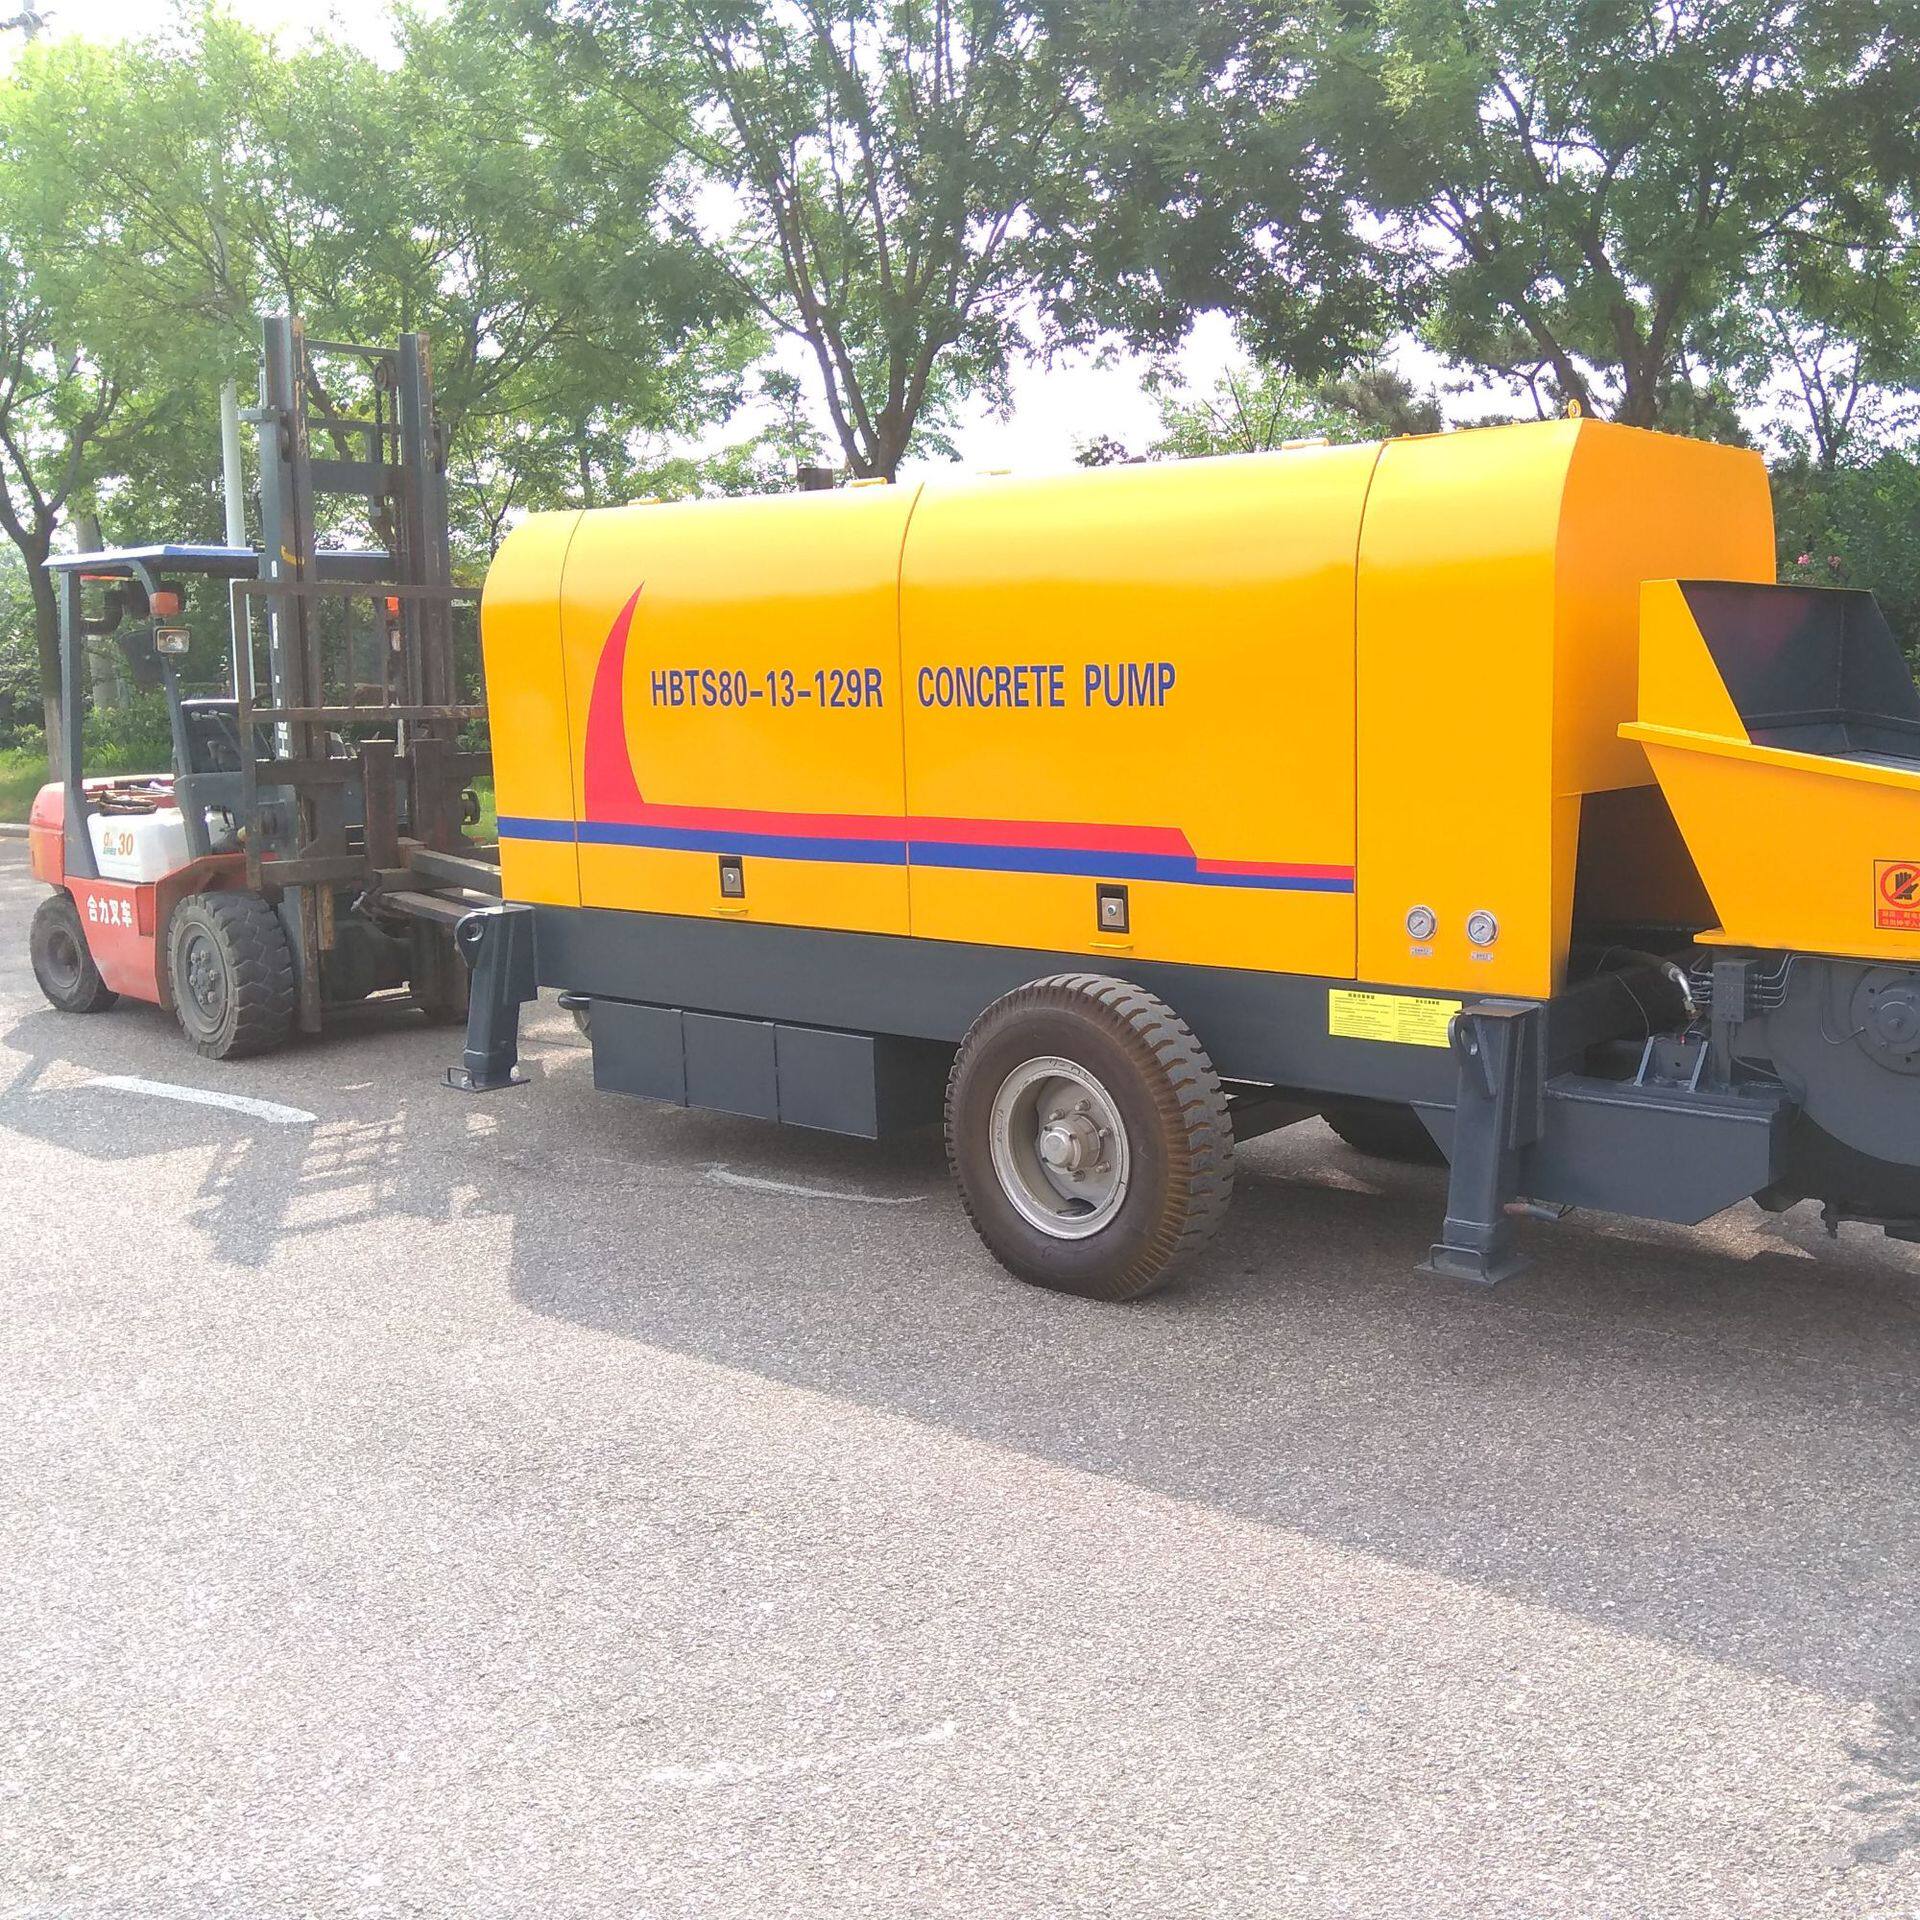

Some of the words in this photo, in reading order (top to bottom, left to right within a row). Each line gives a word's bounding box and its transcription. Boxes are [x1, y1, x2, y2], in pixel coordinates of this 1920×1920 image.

[651, 668, 883, 708] HBTS80-13-129R
[918, 665, 1066, 707] CONCRETE
[1085, 662, 1176, 707] PUMP
[118, 832, 134, 856] 30
[86, 894, 133, 928] 合力叉车
